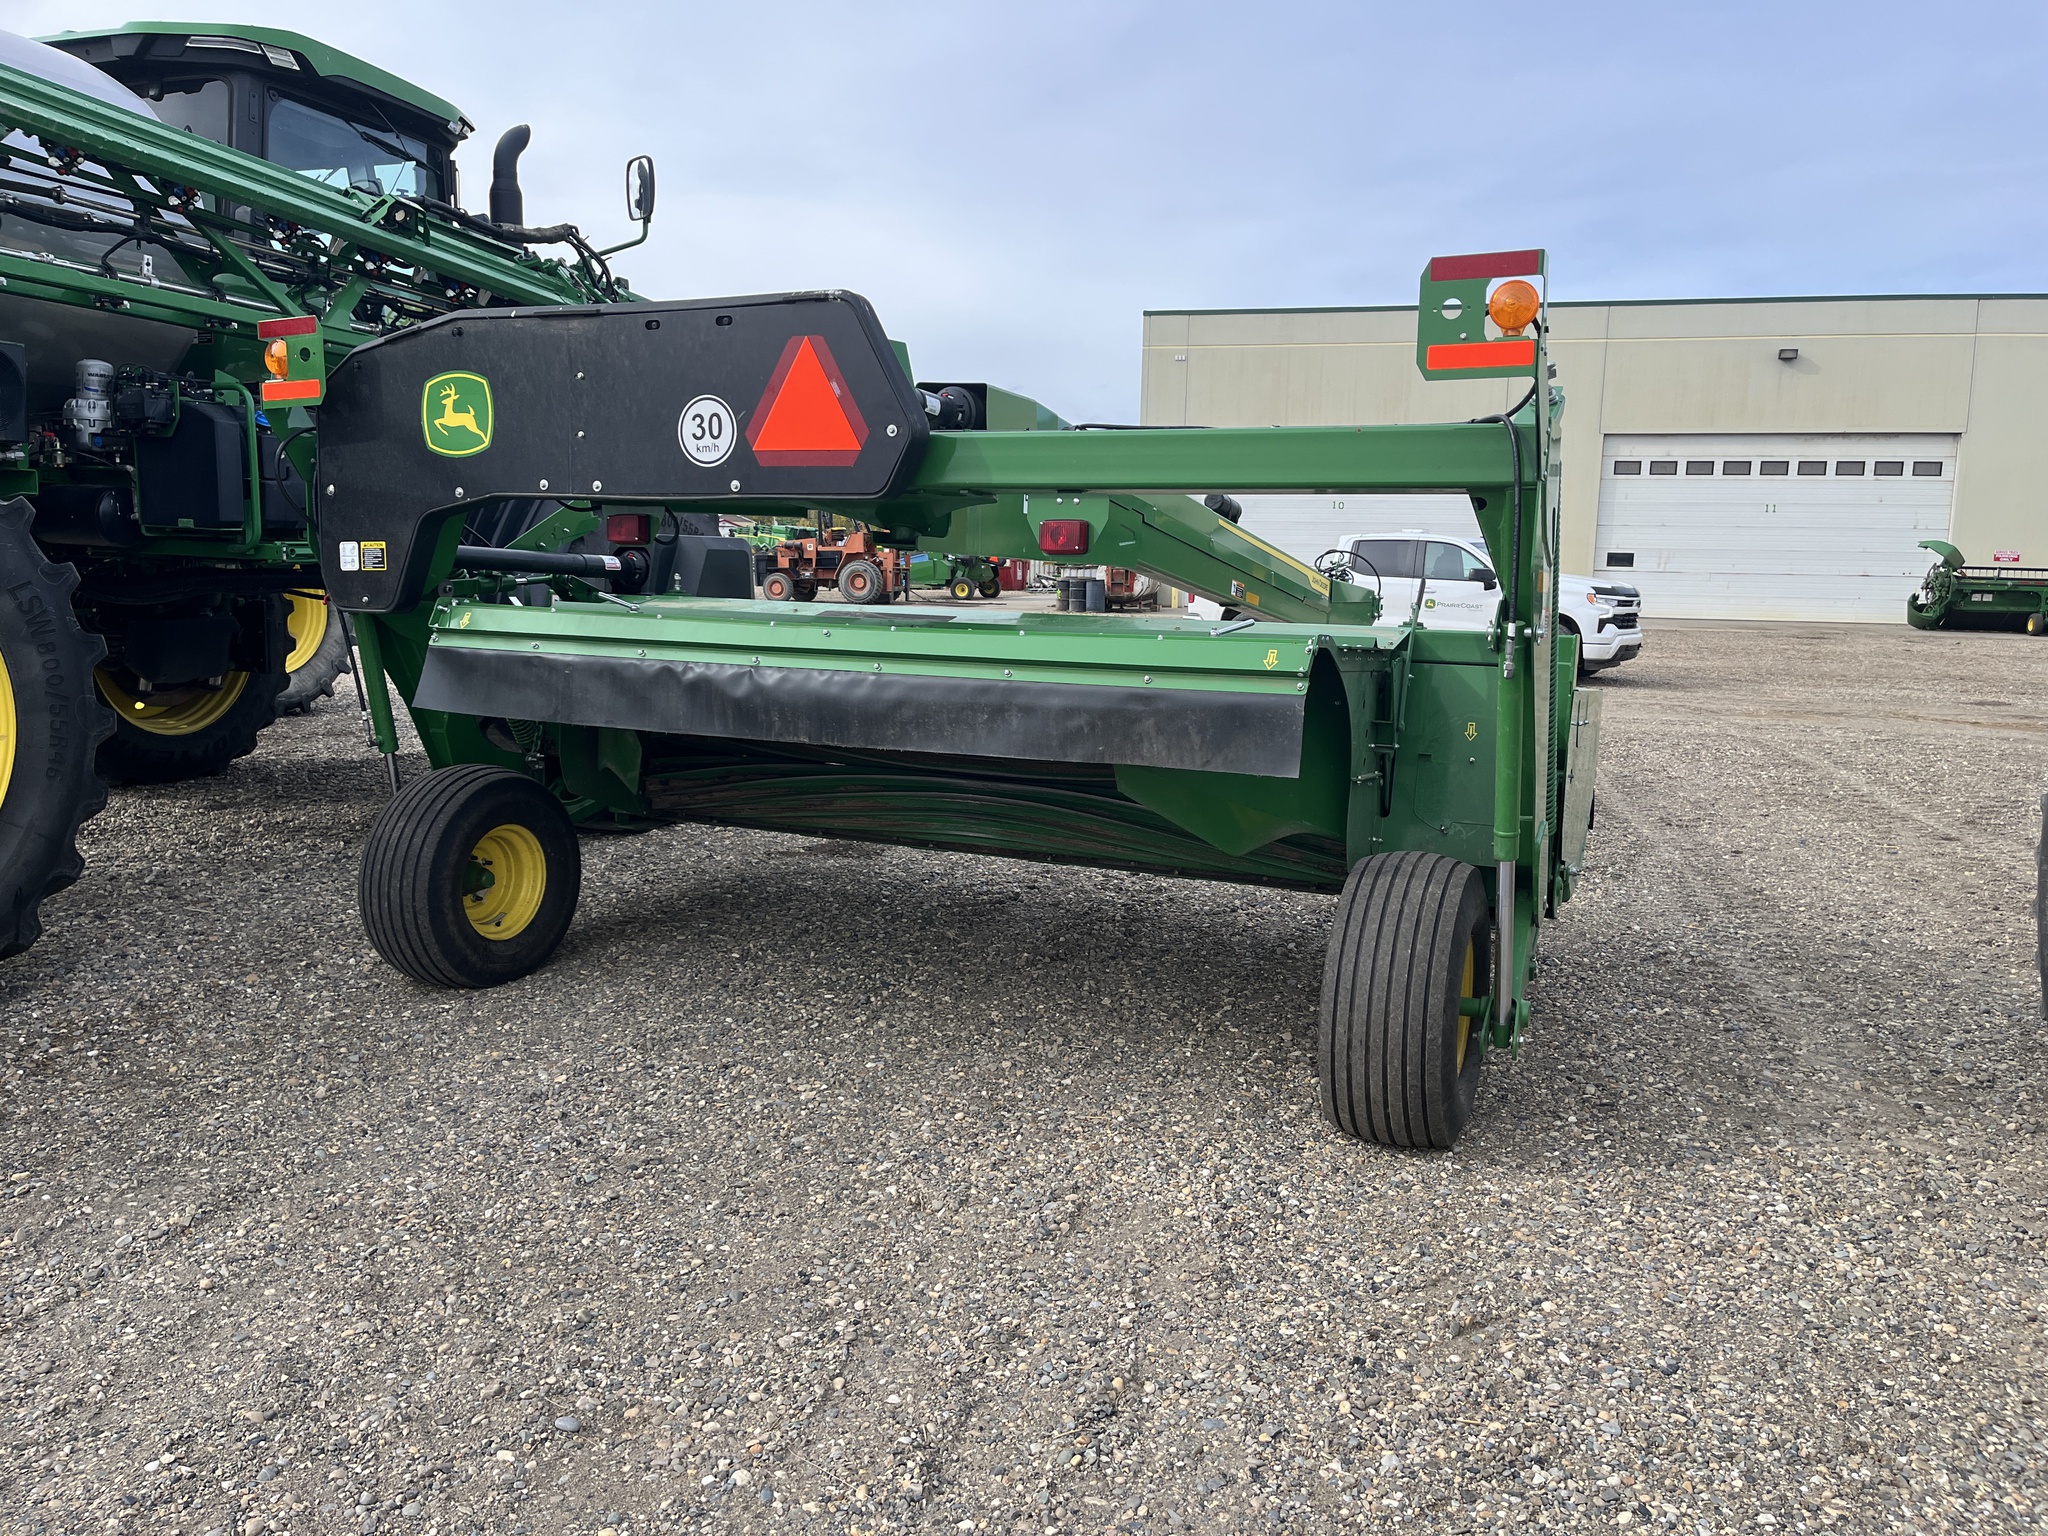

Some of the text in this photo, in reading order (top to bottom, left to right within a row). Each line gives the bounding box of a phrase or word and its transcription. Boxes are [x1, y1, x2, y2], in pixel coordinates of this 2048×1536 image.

[692, 412, 722, 441] 30
[696, 443, 720, 453] km/h
[1332, 501, 1345, 510] 10
[1764, 504, 1776, 513] 11
